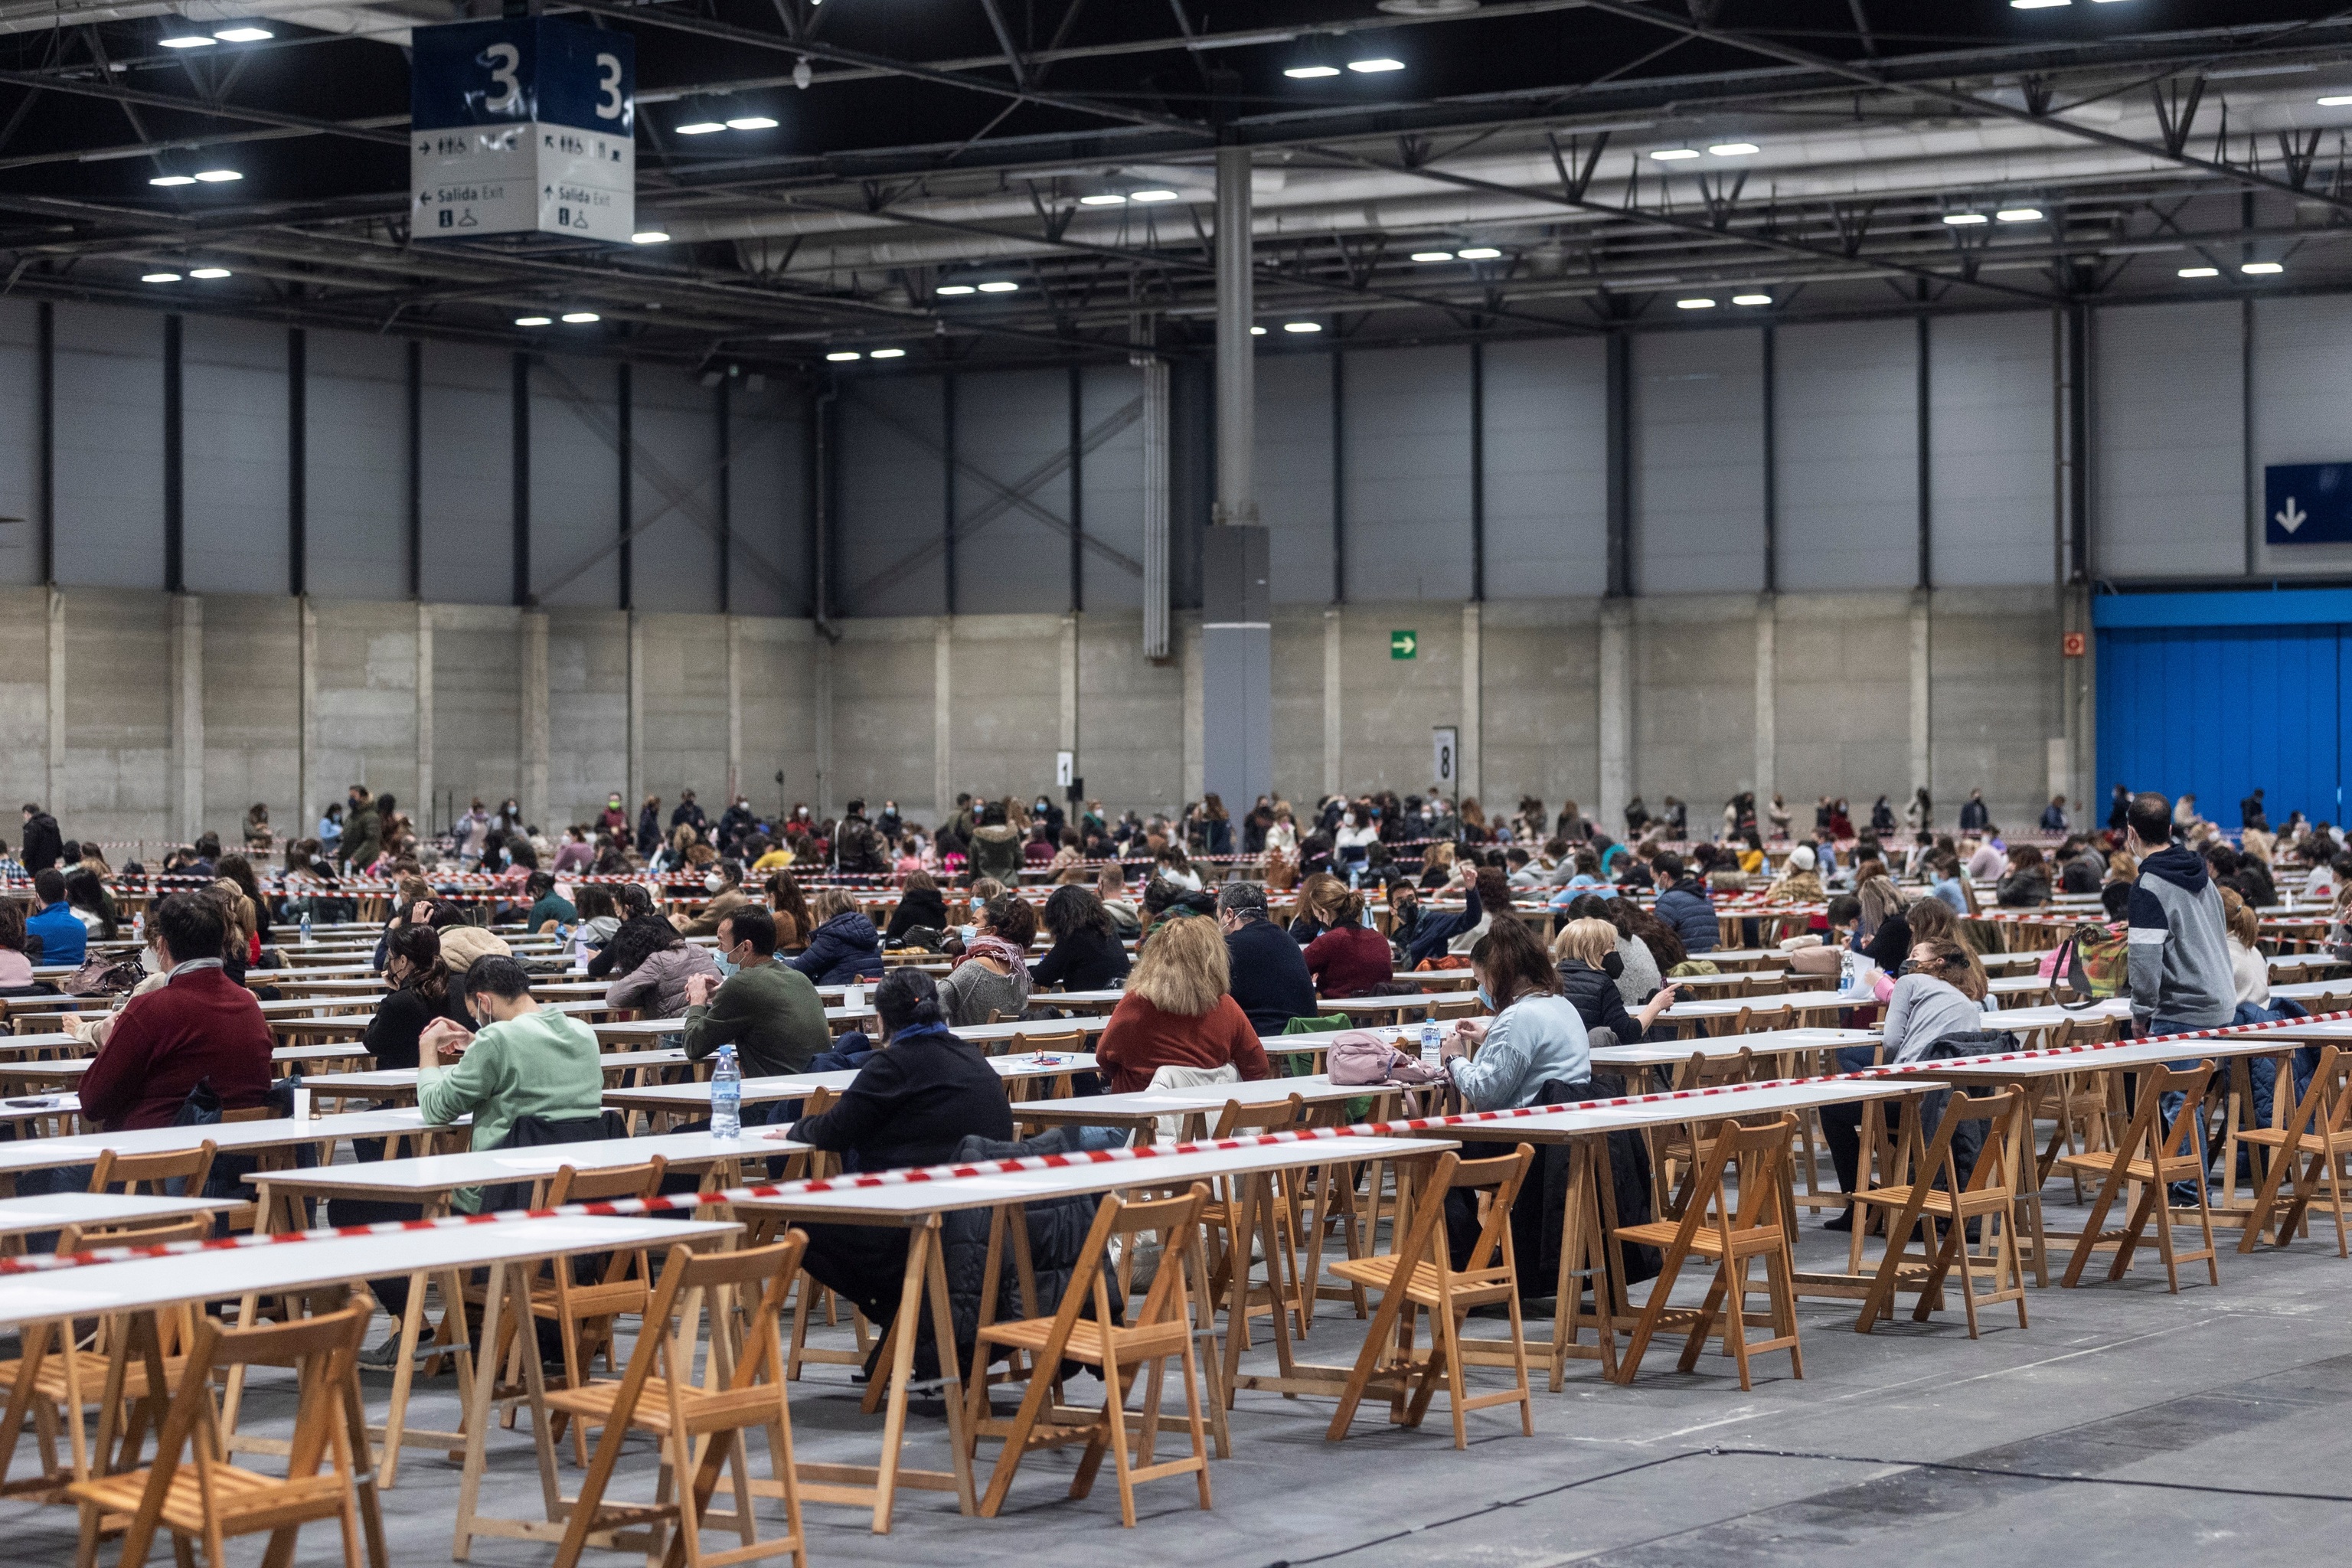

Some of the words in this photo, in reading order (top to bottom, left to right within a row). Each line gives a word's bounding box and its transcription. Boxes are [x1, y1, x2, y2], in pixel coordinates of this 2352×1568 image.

[485, 42, 520, 113] 3
[595, 52, 622, 119] 3
[437, 185, 478, 203] Salida
[482, 185, 505, 200] Exit
[559, 186, 590, 204] Salida
[593, 191, 611, 207] Exit
[1062, 763, 1069, 784] 1
[1441, 746, 1450, 779] 8
